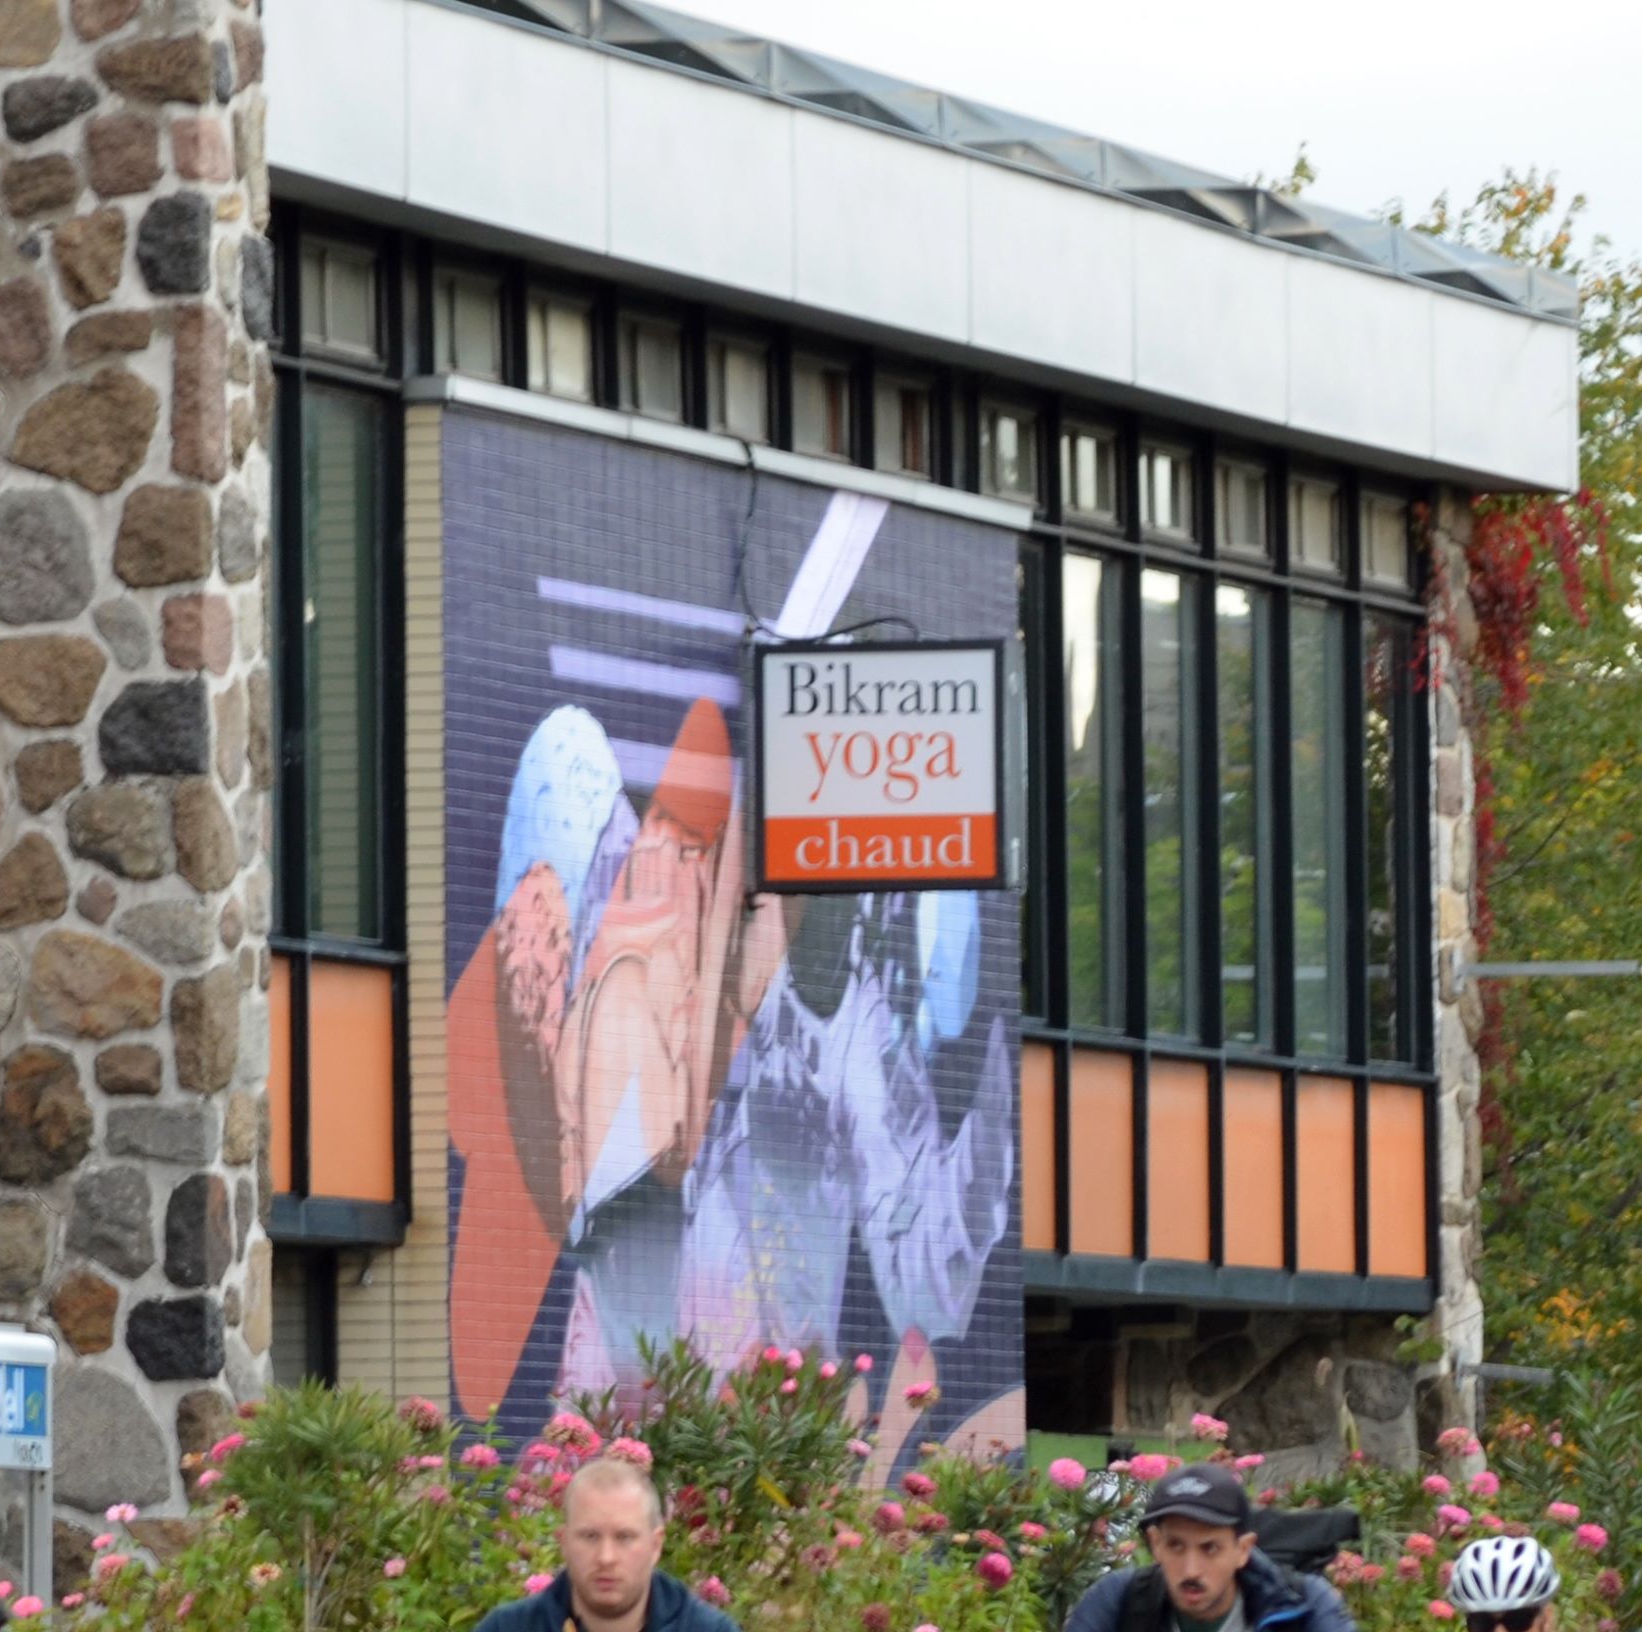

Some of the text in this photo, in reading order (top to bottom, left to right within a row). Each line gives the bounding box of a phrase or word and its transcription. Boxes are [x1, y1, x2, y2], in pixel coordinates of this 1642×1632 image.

[783, 662, 981, 718] Bikram
[806, 731, 962, 805] yoga
[795, 816, 974, 869] chaud
